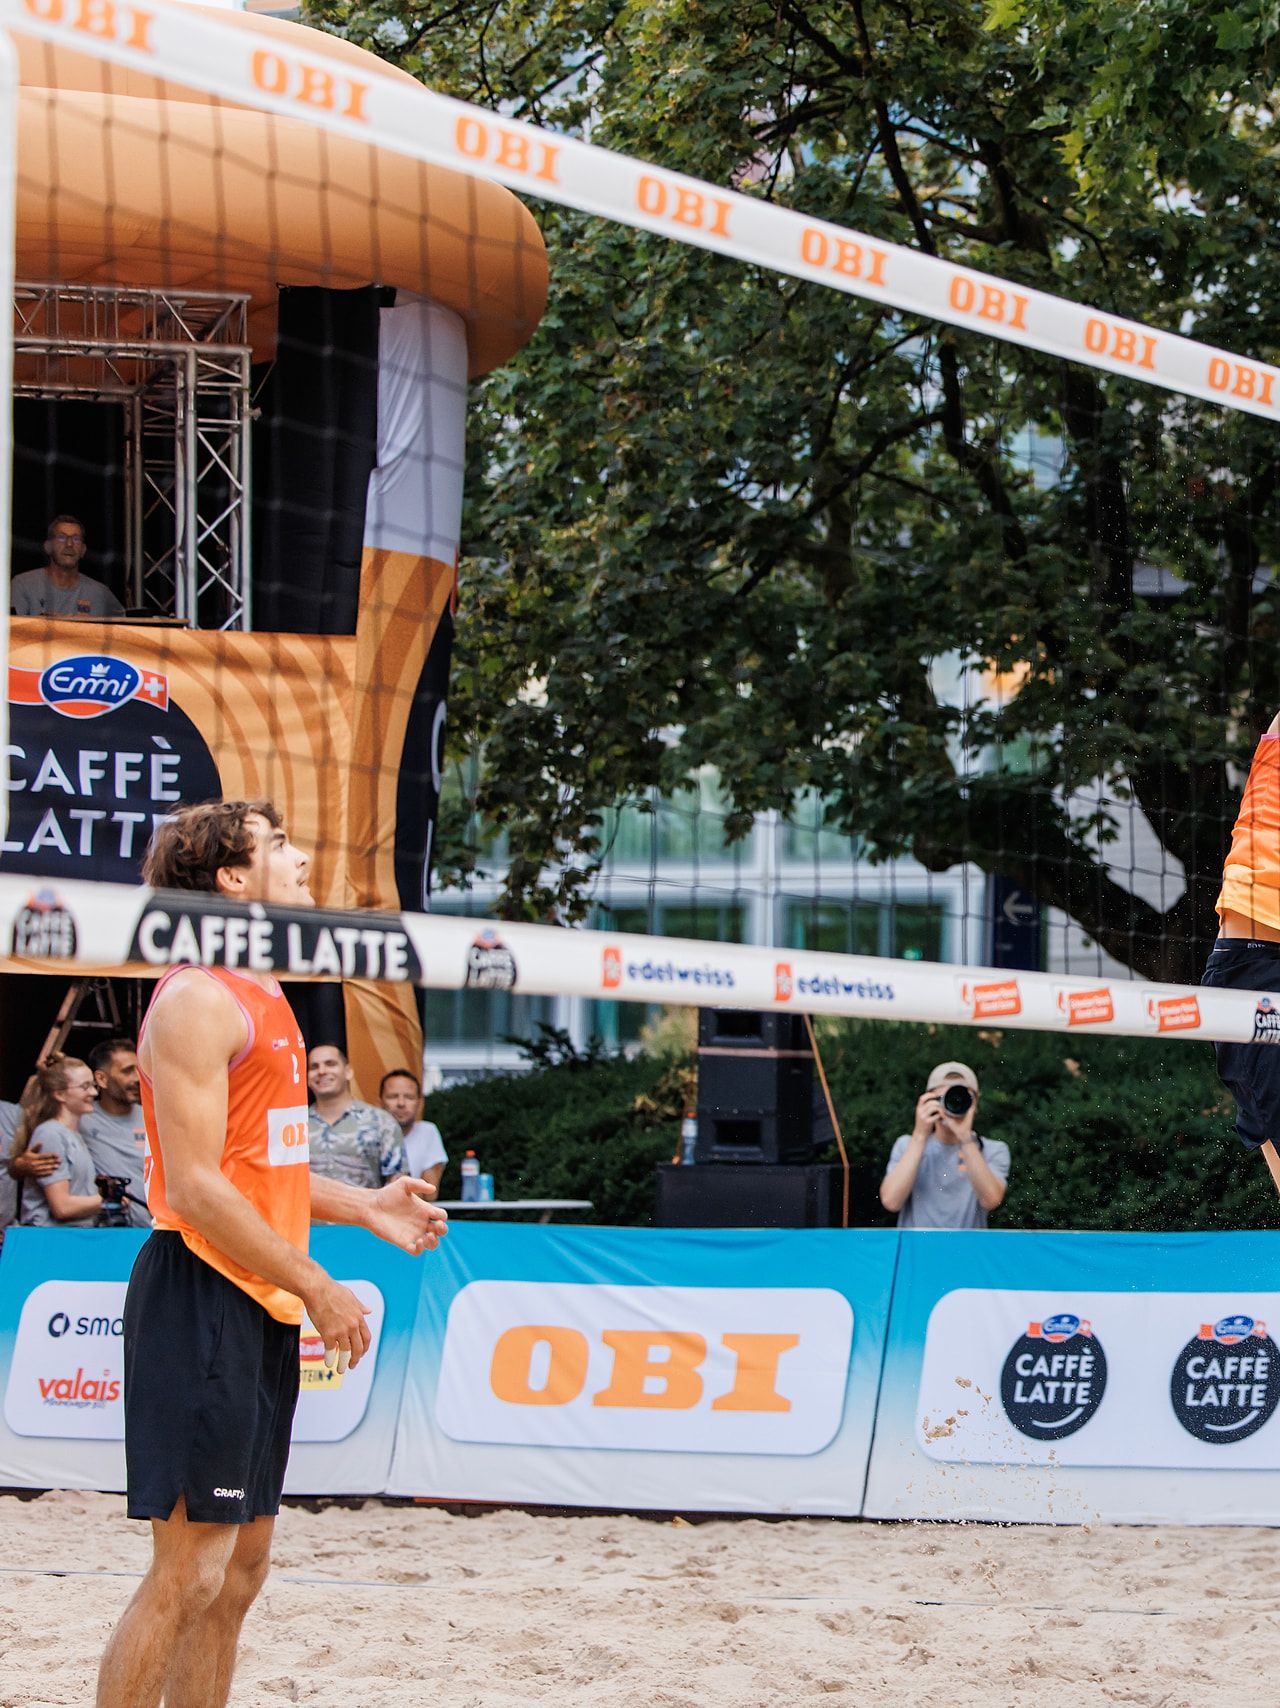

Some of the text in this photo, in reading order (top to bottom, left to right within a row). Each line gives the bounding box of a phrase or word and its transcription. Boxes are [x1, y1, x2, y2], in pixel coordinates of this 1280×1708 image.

[22, 0, 155, 54] OBI
[250, 48, 372, 121] OBI
[453, 116, 563, 184] OBI
[635, 175, 732, 237] OBI
[799, 227, 887, 286] OBI
[948, 275, 1029, 330] OBI
[1083, 318, 1157, 370] OBI
[1207, 357, 1275, 405] OBI
[49, 666, 132, 696] Emmi
[2, 735, 181, 801] CAFFÈ
[2, 808, 177, 858] LATT
[138, 903, 411, 981] CAFFÈ LATTE
[627, 962, 736, 988] edelweiss
[797, 976, 895, 1001] edelweiss
[38, 1366, 120, 1402] valais
[488, 1325, 800, 1413] OBI
[1016, 1347, 1094, 1378] CAFFÈ
[1186, 1350, 1270, 1380] CAFFÈ
[1014, 1382, 1091, 1405] LATTE
[1185, 1384, 1267, 1407] LATTE
[213, 1487, 241, 1500] CRAFT
